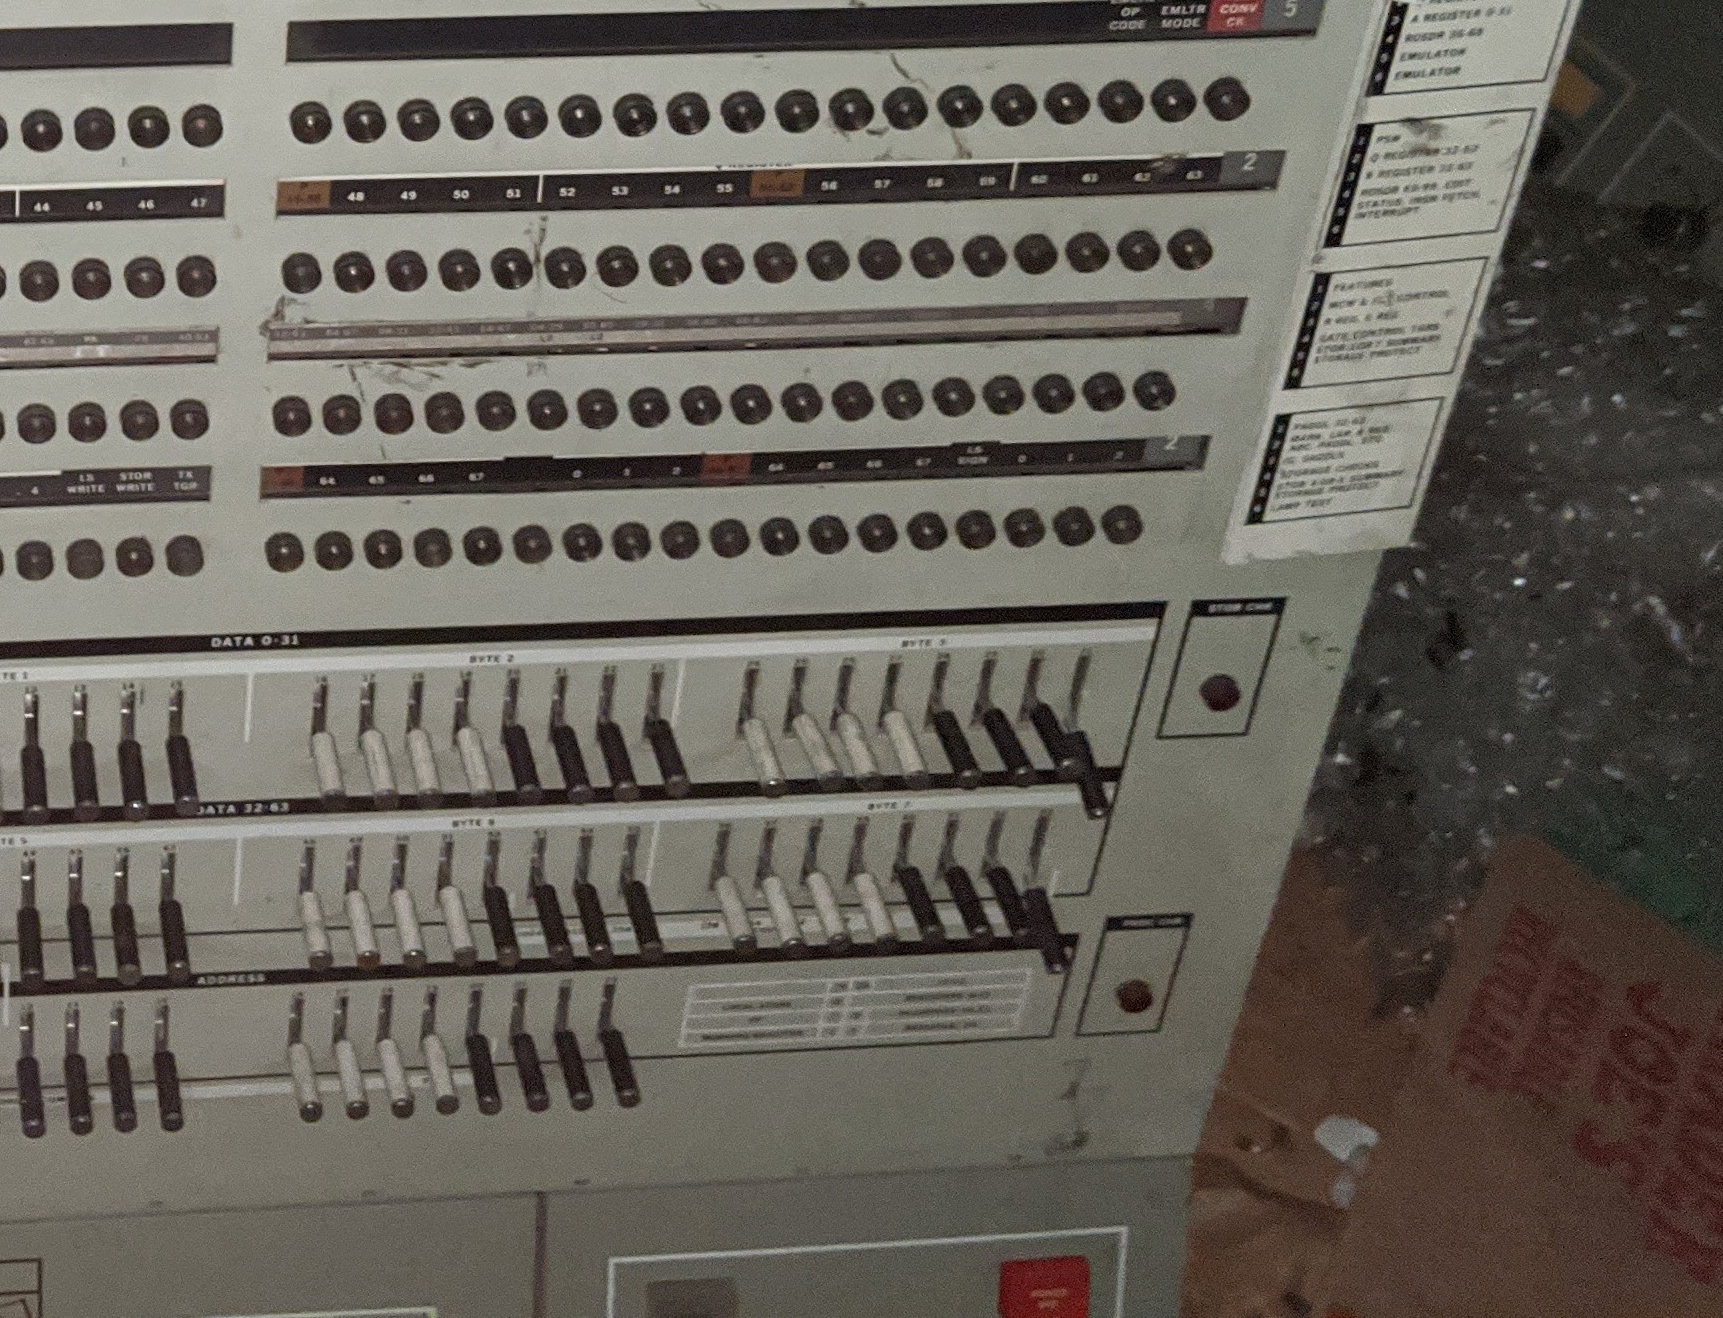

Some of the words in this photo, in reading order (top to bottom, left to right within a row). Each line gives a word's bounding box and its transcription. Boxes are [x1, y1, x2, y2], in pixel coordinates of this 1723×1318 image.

[1160, 4, 1207, 16] EMLTR
[1218, 2, 1258, 15] CONV
[1284, 0, 1298, 18] 5
[1422, 8, 1483, 23] REGISTER
[1108, 18, 1146, 31] CODE
[1160, 16, 1202, 30] MODE
[1399, 46, 1467, 63] EMULATOR
[1393, 65, 1462, 81] EMULATOR
[1242, 152, 1256, 171] 2
[210, 636, 255, 649] DATA
[196, 972, 266, 986] ADDRESS
